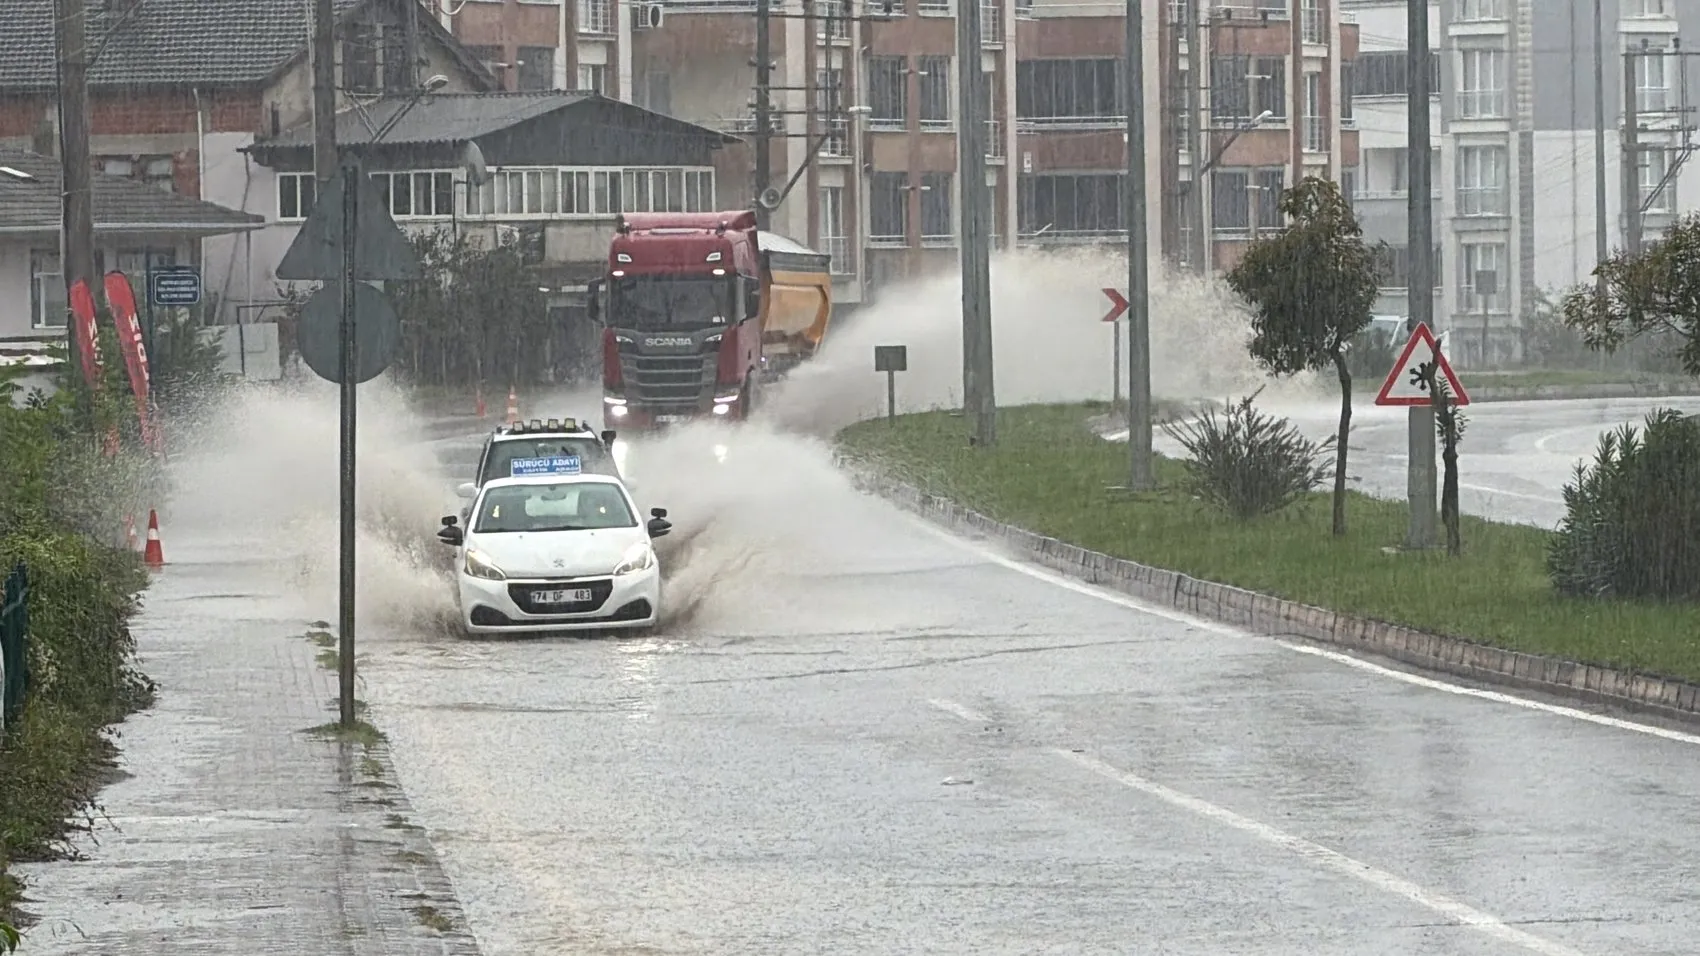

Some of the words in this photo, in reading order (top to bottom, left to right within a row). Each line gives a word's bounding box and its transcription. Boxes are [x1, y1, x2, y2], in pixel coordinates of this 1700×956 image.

[645, 337, 693, 346] SCANIA
[552, 458, 578, 467] ADAYI
[535, 591, 547, 601] 74
[575, 589, 591, 600] 483
